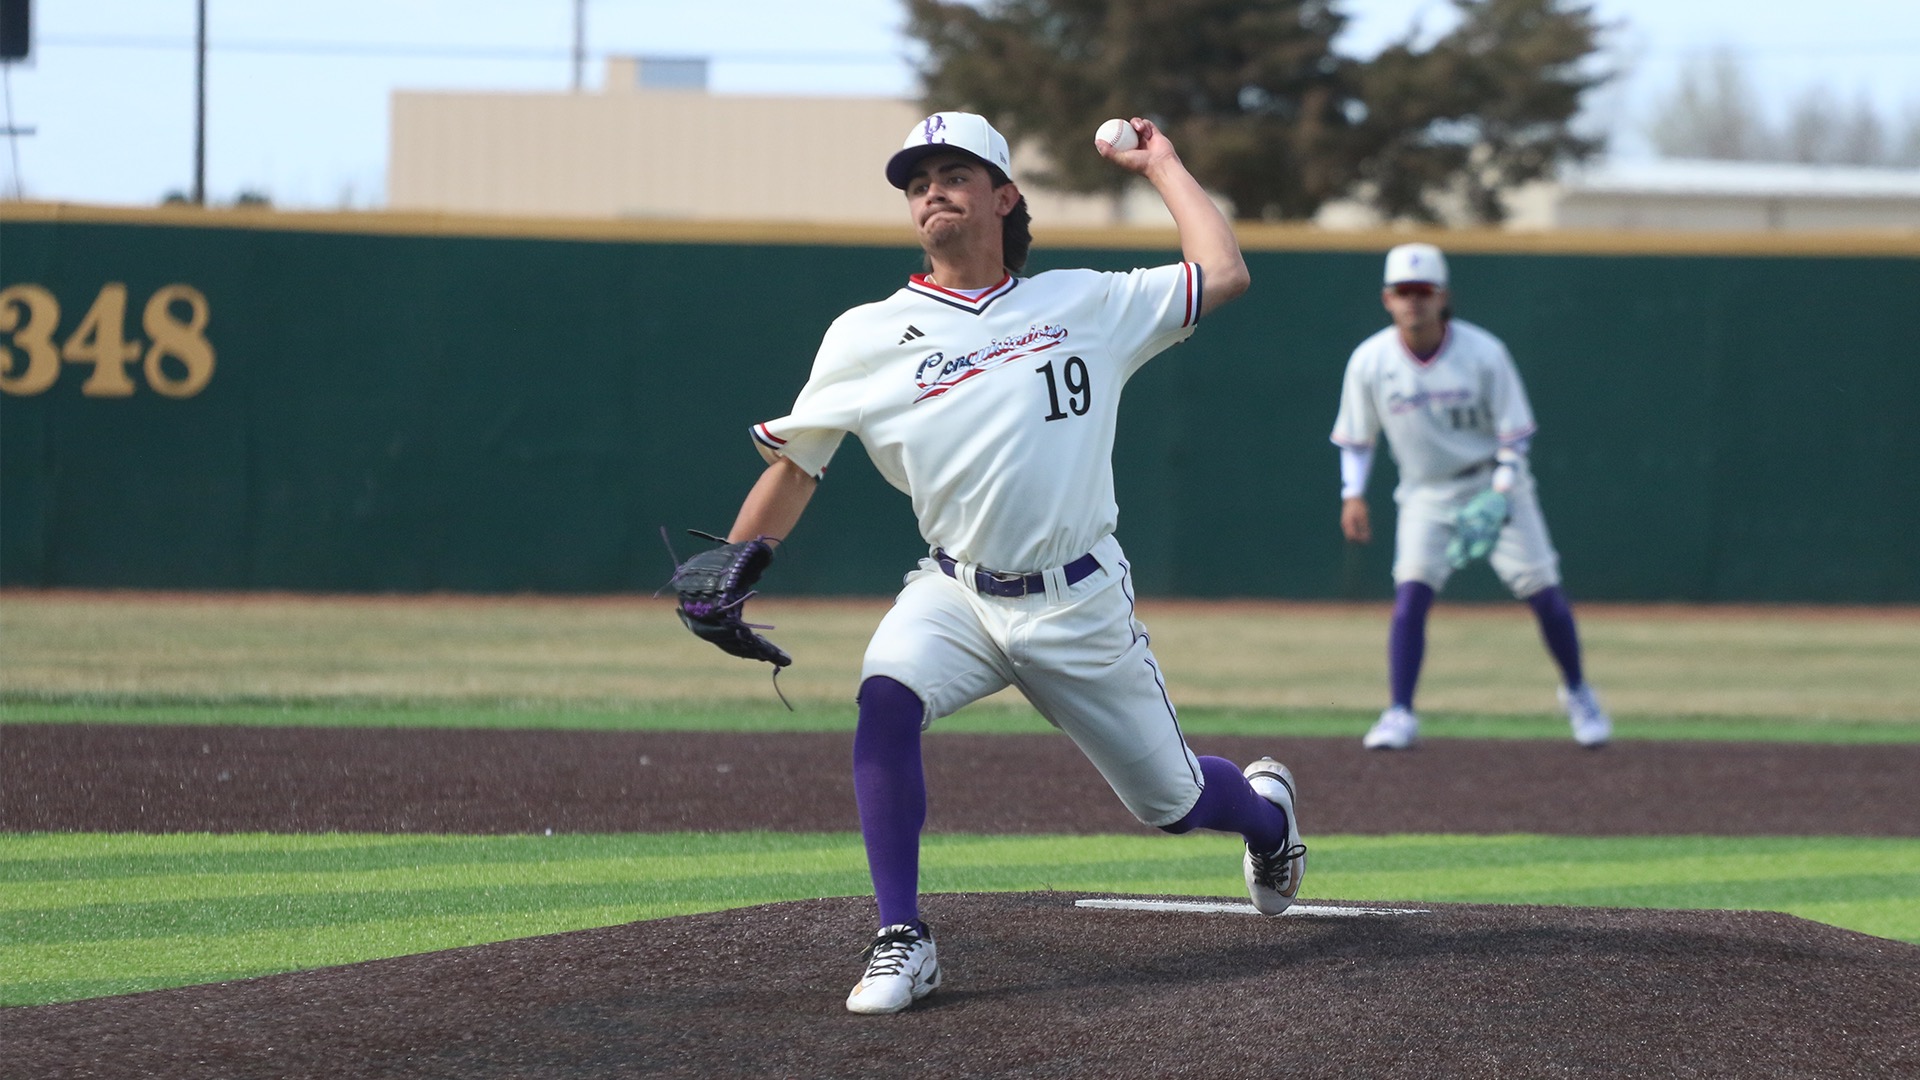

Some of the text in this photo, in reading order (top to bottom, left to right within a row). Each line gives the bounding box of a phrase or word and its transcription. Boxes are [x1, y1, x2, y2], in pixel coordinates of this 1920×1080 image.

[0, 282, 216, 399] 348
[914, 324, 1068, 396] Conquistadors
[1035, 356, 1092, 422] 19
